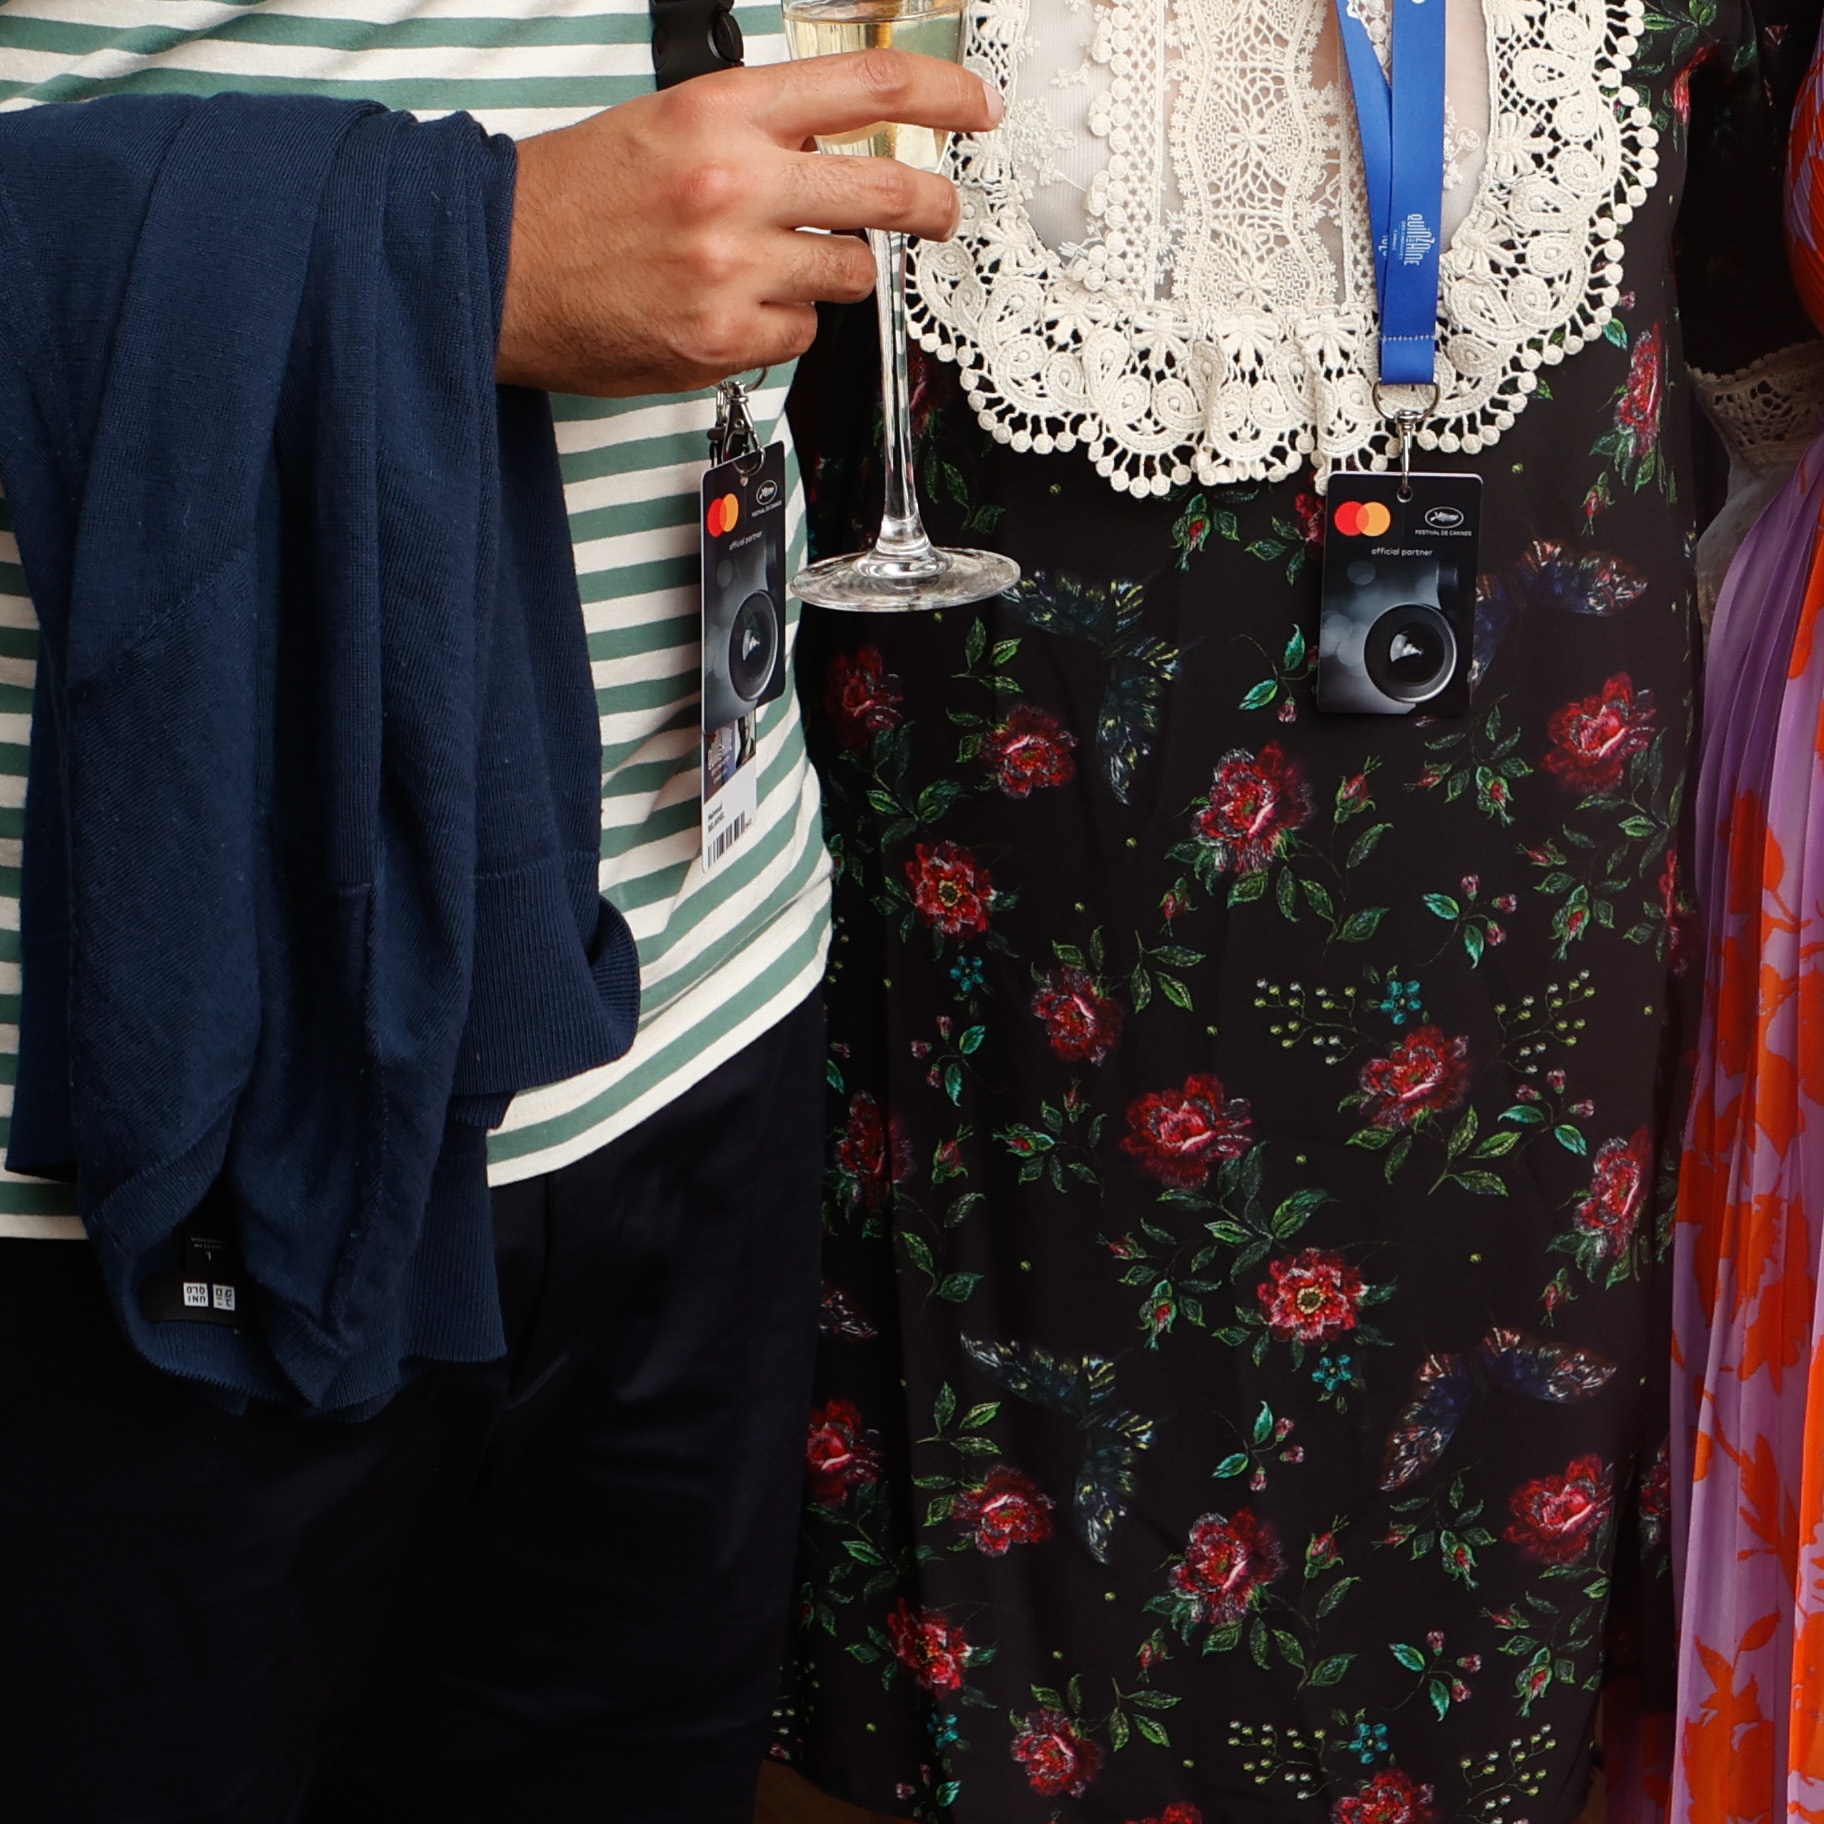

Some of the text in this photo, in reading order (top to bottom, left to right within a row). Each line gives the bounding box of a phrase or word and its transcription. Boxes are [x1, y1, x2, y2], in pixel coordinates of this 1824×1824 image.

[1371, 547, 1433, 557] official partner
[186, 1286, 205, 1294] QLO
[188, 1295, 206, 1303] UNI
